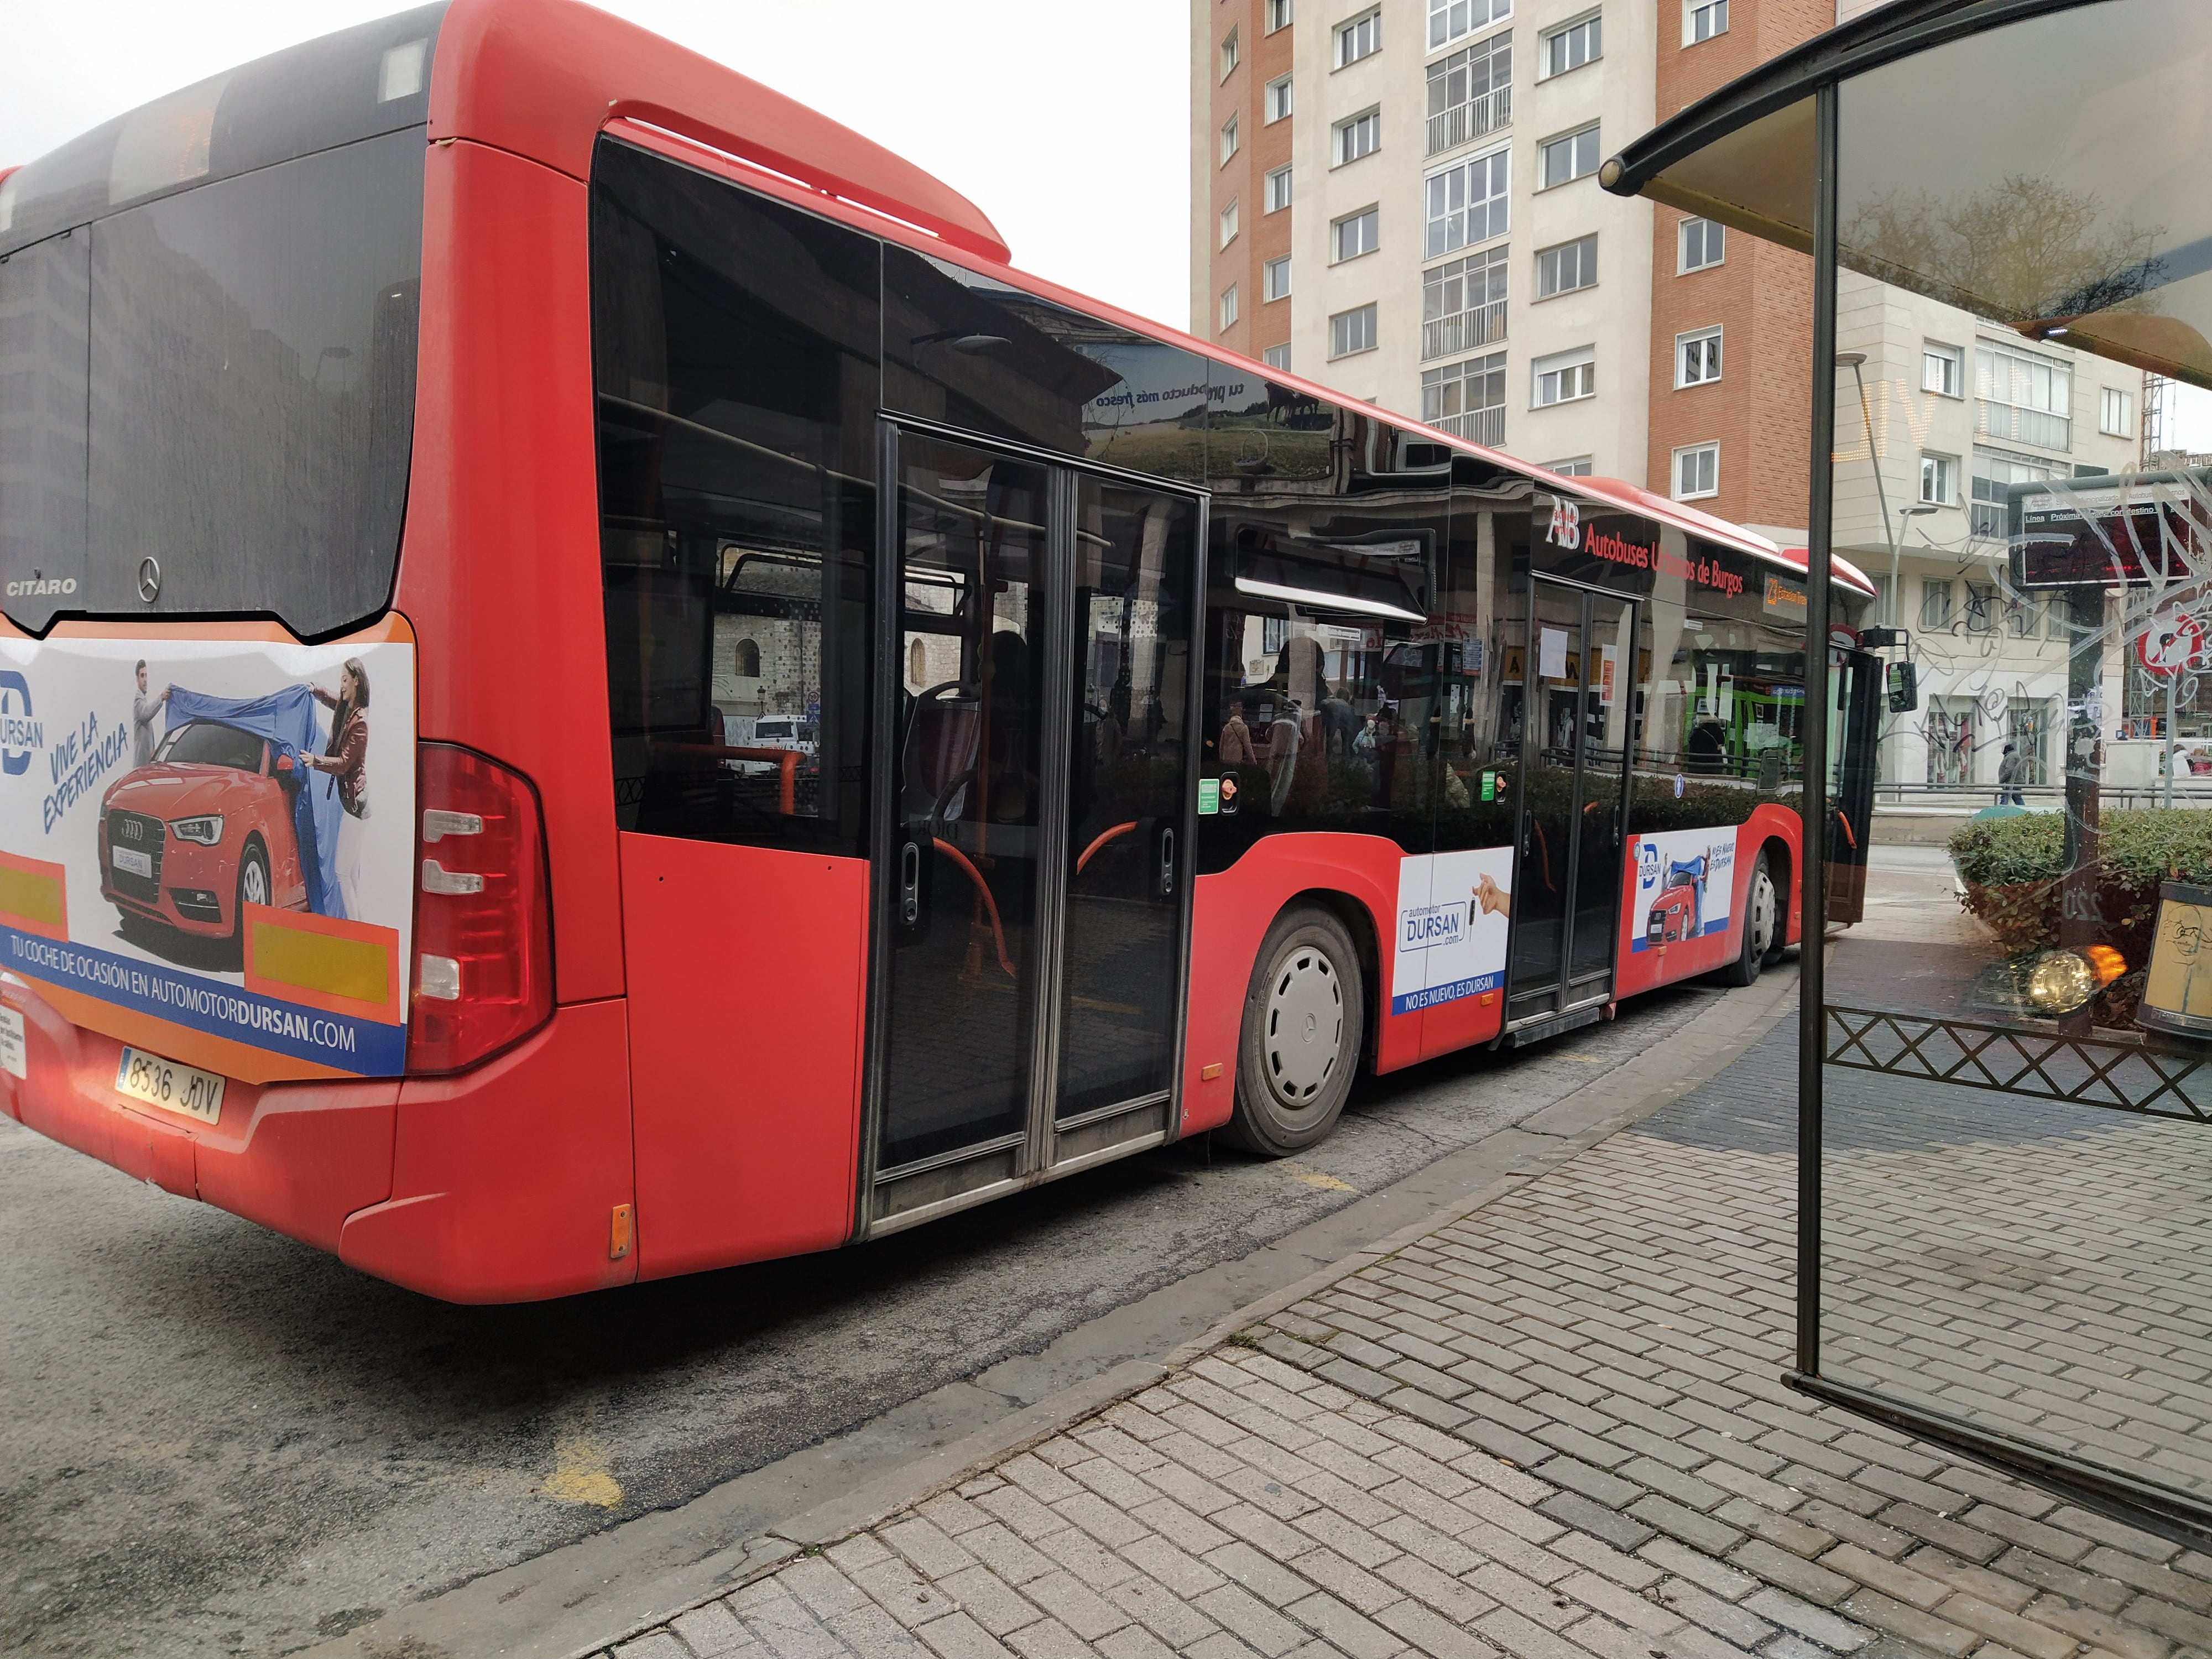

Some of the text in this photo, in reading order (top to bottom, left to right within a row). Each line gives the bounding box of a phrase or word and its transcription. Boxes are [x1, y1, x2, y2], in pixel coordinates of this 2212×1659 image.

[2051, 513, 2080, 521] Próxima
[1584, 523, 1648, 568] Autobuses
[1698, 556, 1710, 585] de
[1712, 560, 1743, 599] Burgos
[6, 578, 77, 597] CITARO
[0, 719, 44, 749] URSAN
[50, 711, 99, 785] VIVE LA
[44, 722, 128, 834] EXPERIENCIA
[1639, 864, 1661, 877] DURSAN
[1408, 904, 1441, 917] automotor
[1407, 912, 1459, 942] DURSAN
[1443, 935, 1459, 946] .com
[10, 935, 355, 1053] TU COCHE DE OCASIÓN EN AUTOMOTORDURSAN.COM
[1406, 975, 1494, 1011] NO ES NUEVO, ES DURSAN
[129, 1057, 218, 1115] 8536 JDV
